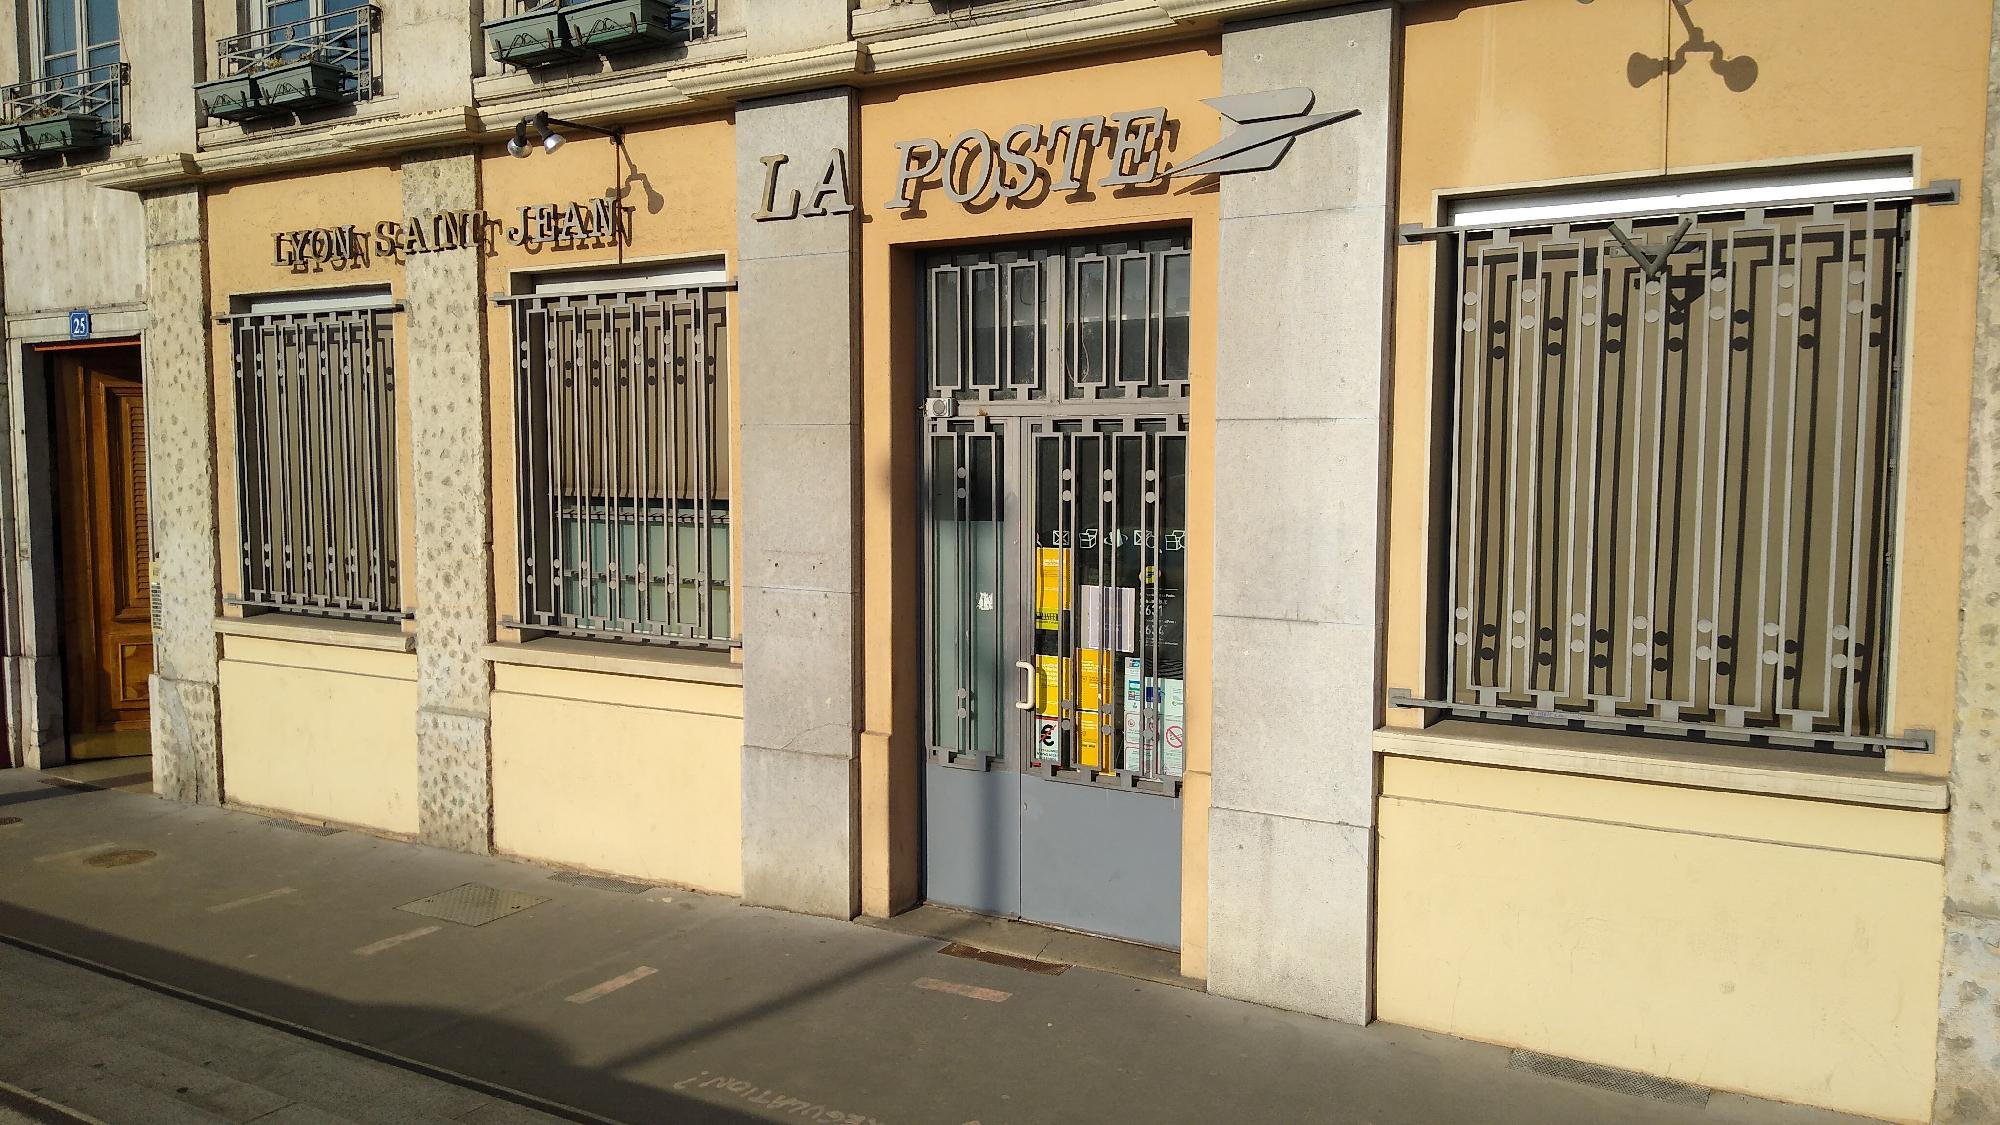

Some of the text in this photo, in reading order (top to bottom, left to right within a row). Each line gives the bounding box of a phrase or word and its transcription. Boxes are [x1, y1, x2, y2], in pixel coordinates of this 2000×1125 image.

[750, 106, 1168, 223] LA POSTE
[270, 195, 619, 267] LYON SAINT JEAN
[73, 317, 86, 334] 25
